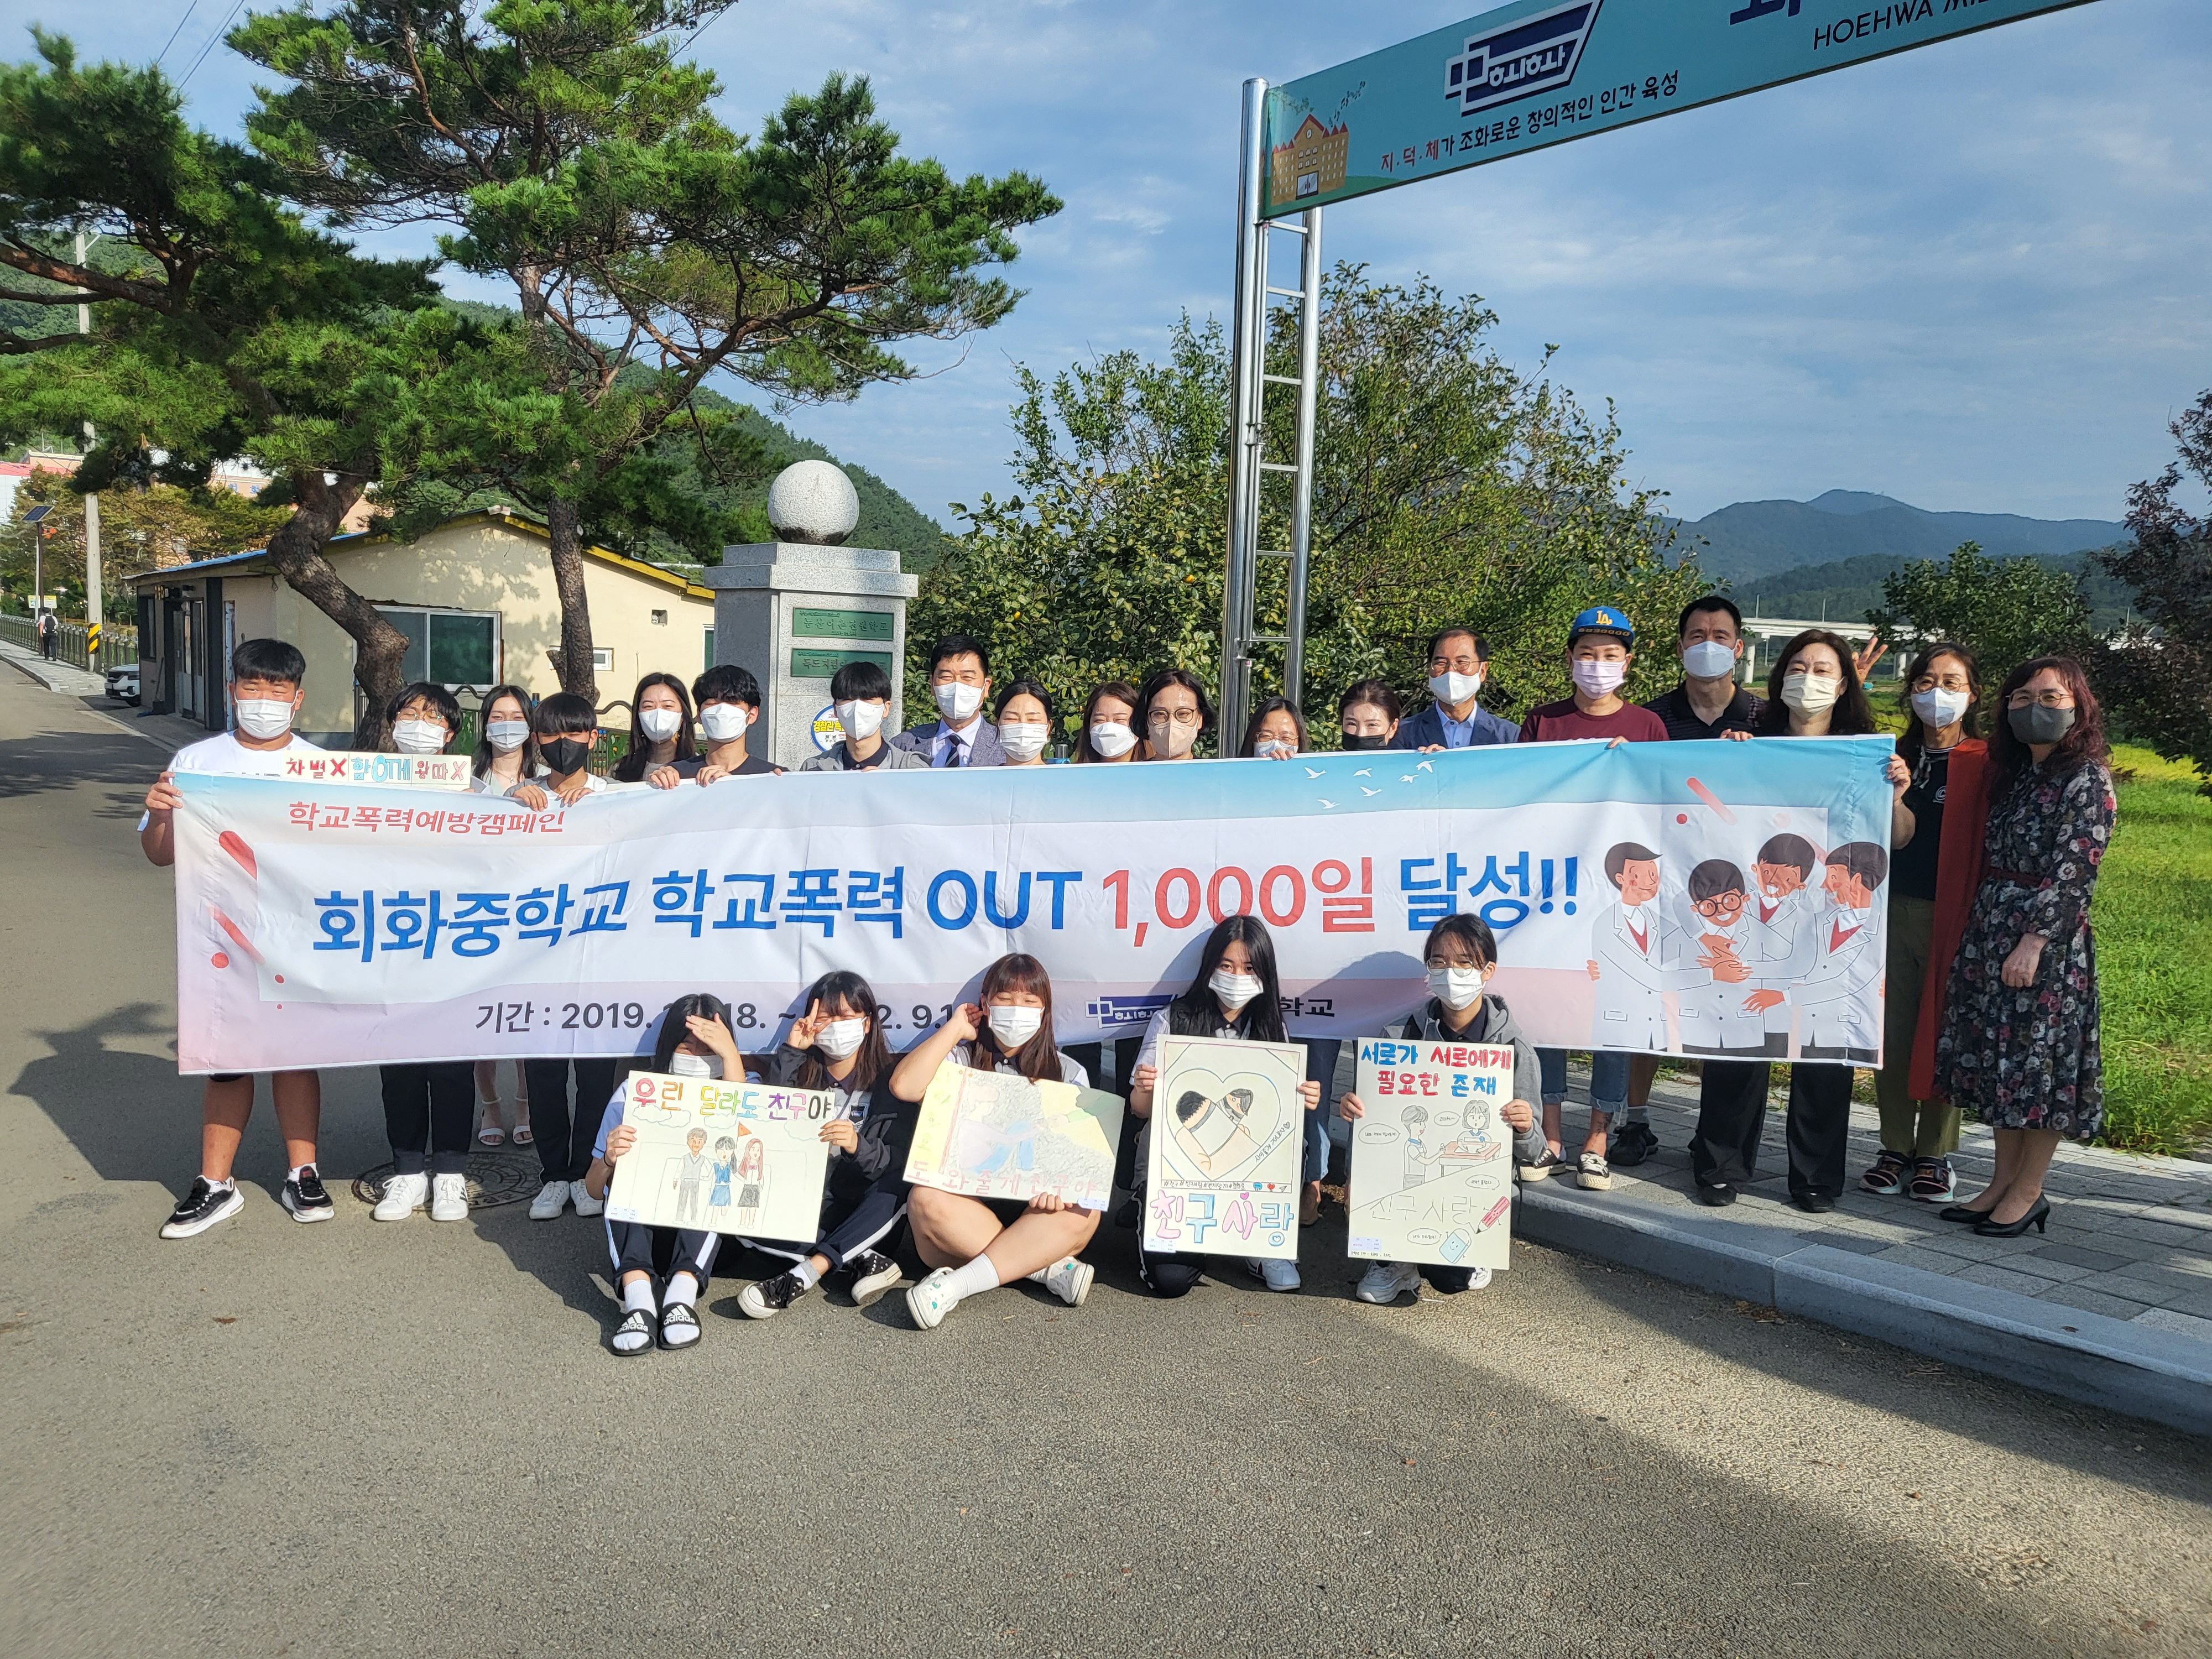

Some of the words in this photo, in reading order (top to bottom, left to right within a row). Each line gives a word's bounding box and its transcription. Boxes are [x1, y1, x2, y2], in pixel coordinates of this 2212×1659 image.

[1813, 0, 1934, 50] HOEHWA
[1459, 116, 1521, 152] 조화로운
[1527, 94, 1593, 134] 창의적인
[1600, 82, 1636, 114] 인간
[1641, 70, 1678, 100] 육성
[1595, 610, 1613, 625] LA
[289, 800, 566, 836] 학교폭력예방캠페인
[312, 880, 630, 963] 회화중학교
[651, 865, 904, 940] 학교폭력
[926, 869, 1084, 932] OUT
[1101, 857, 1376, 947] 1,000일
[1399, 851, 1578, 931] 달성!!
[475, 1000, 535, 1033] 기간
[561, 1002, 653, 1029] 2019.
[1361, 1042, 1418, 1066] 서로가
[1430, 1046, 1511, 1070] 서로에게
[633, 1077, 684, 1111] 우린
[700, 1086, 759, 1119] 달라도
[768, 1092, 832, 1120] 친구야
[1377, 1070, 1439, 1096] 필요한
[1451, 1073, 1496, 1098] 존재
[1149, 1189, 1295, 1248] 친구사랑
[616, 1323, 649, 1334] adidas
[663, 1314, 696, 1326] adidas
